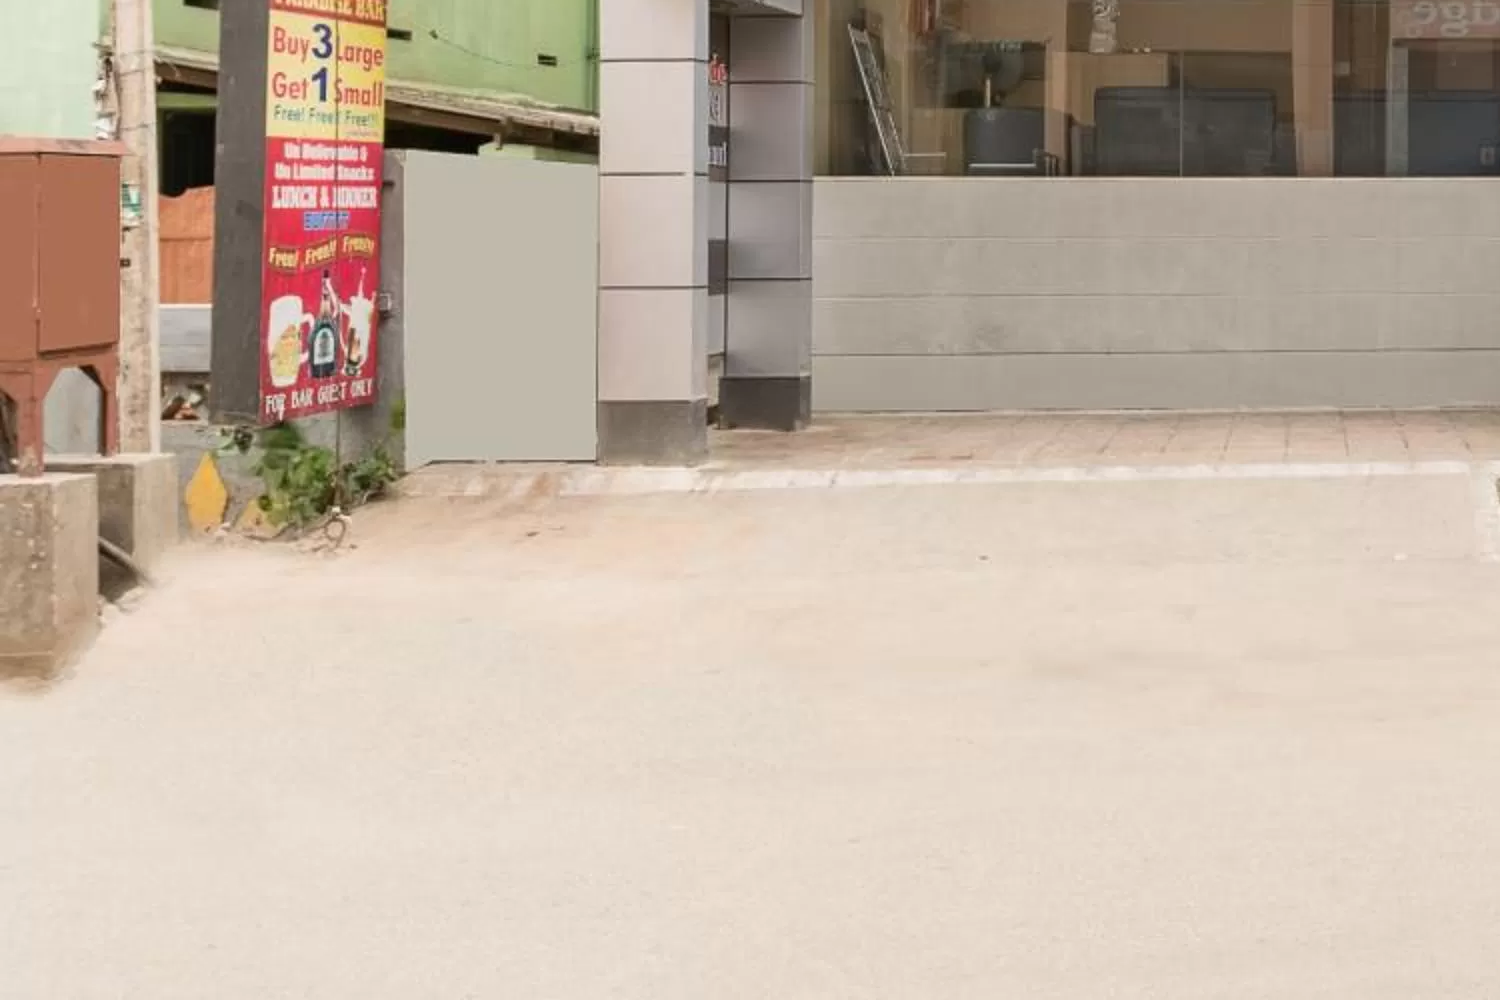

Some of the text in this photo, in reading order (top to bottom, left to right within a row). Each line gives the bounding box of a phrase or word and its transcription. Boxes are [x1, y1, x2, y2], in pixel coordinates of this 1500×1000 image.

[273, 22, 384, 72] Buy 3 Large
[272, 65, 383, 108] Get 1 Small
